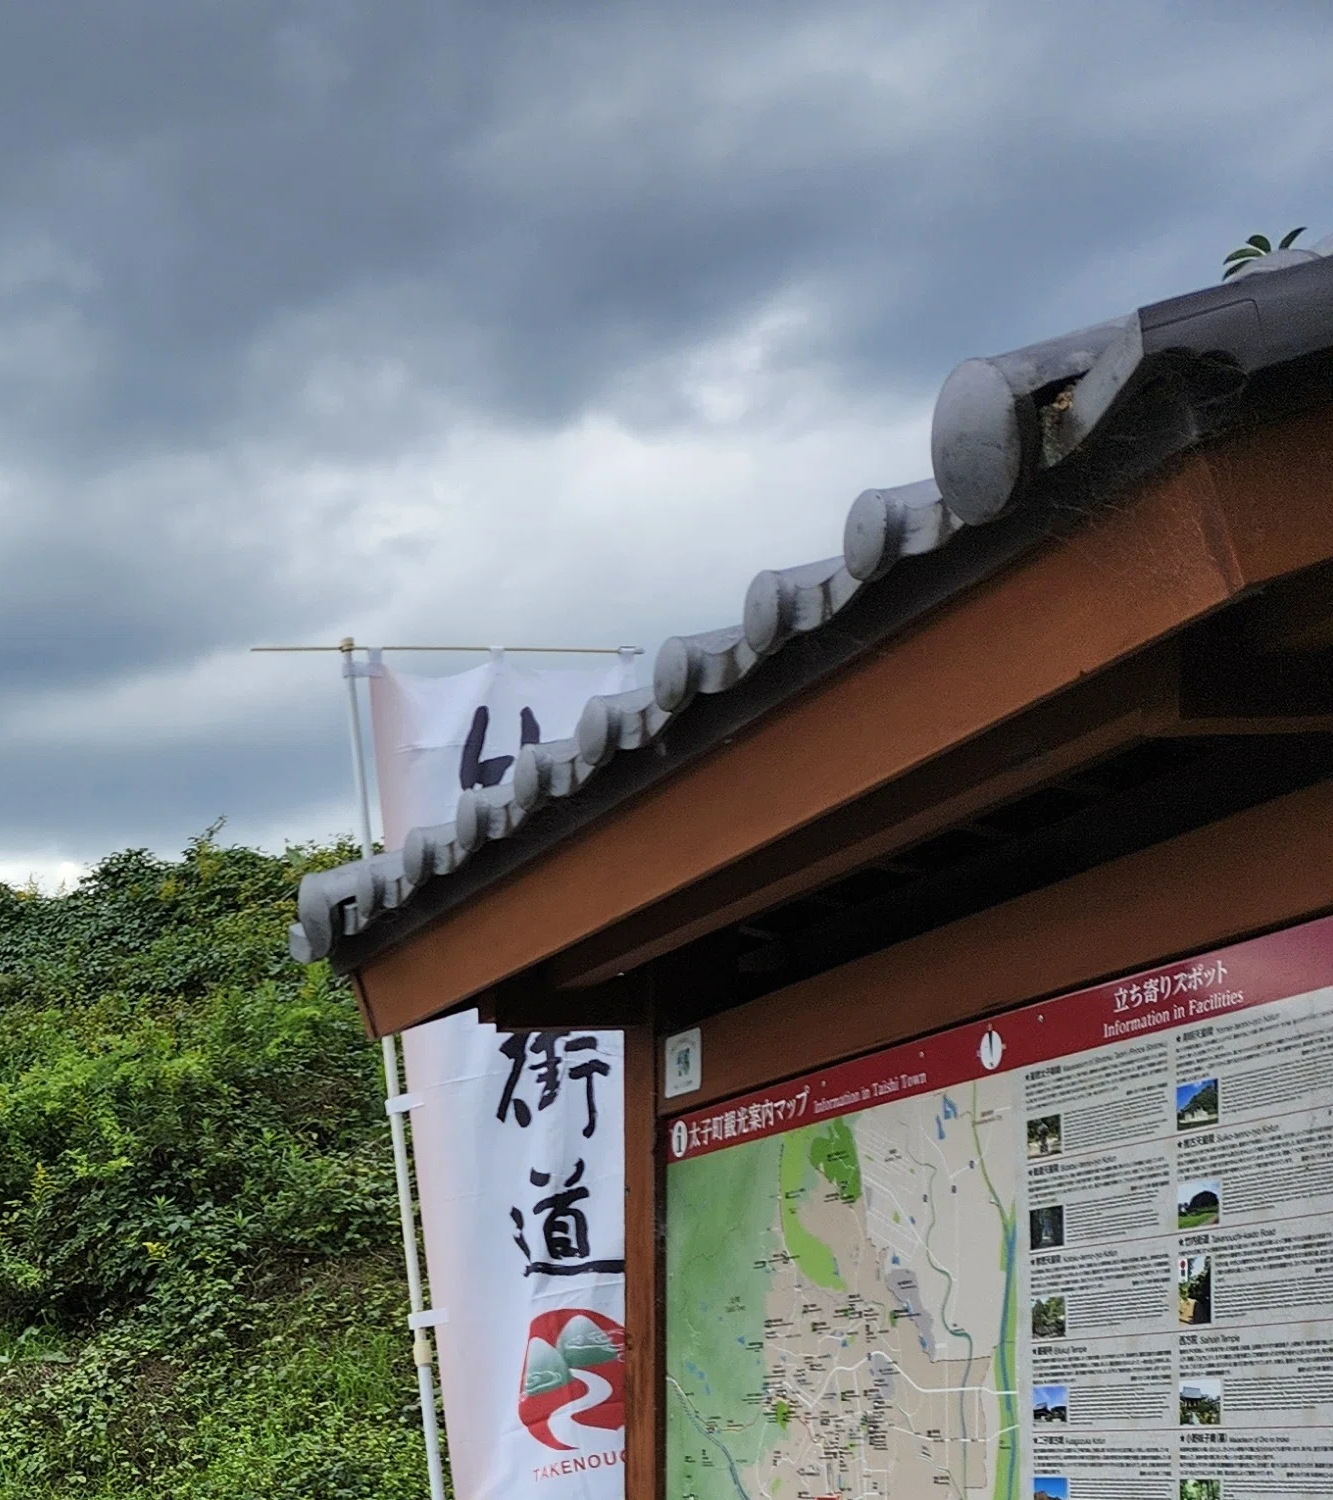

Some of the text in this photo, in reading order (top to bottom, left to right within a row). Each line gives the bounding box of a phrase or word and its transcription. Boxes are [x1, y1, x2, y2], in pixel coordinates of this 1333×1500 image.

[1113, 960, 1227, 1013] 立ち寄りスポット
[1103, 989, 1244, 1039] Information in Facilities
[688, 1085, 810, 1148] 太子町観光案内マップ
[813, 1071, 927, 1114] Information in Taishi Town
